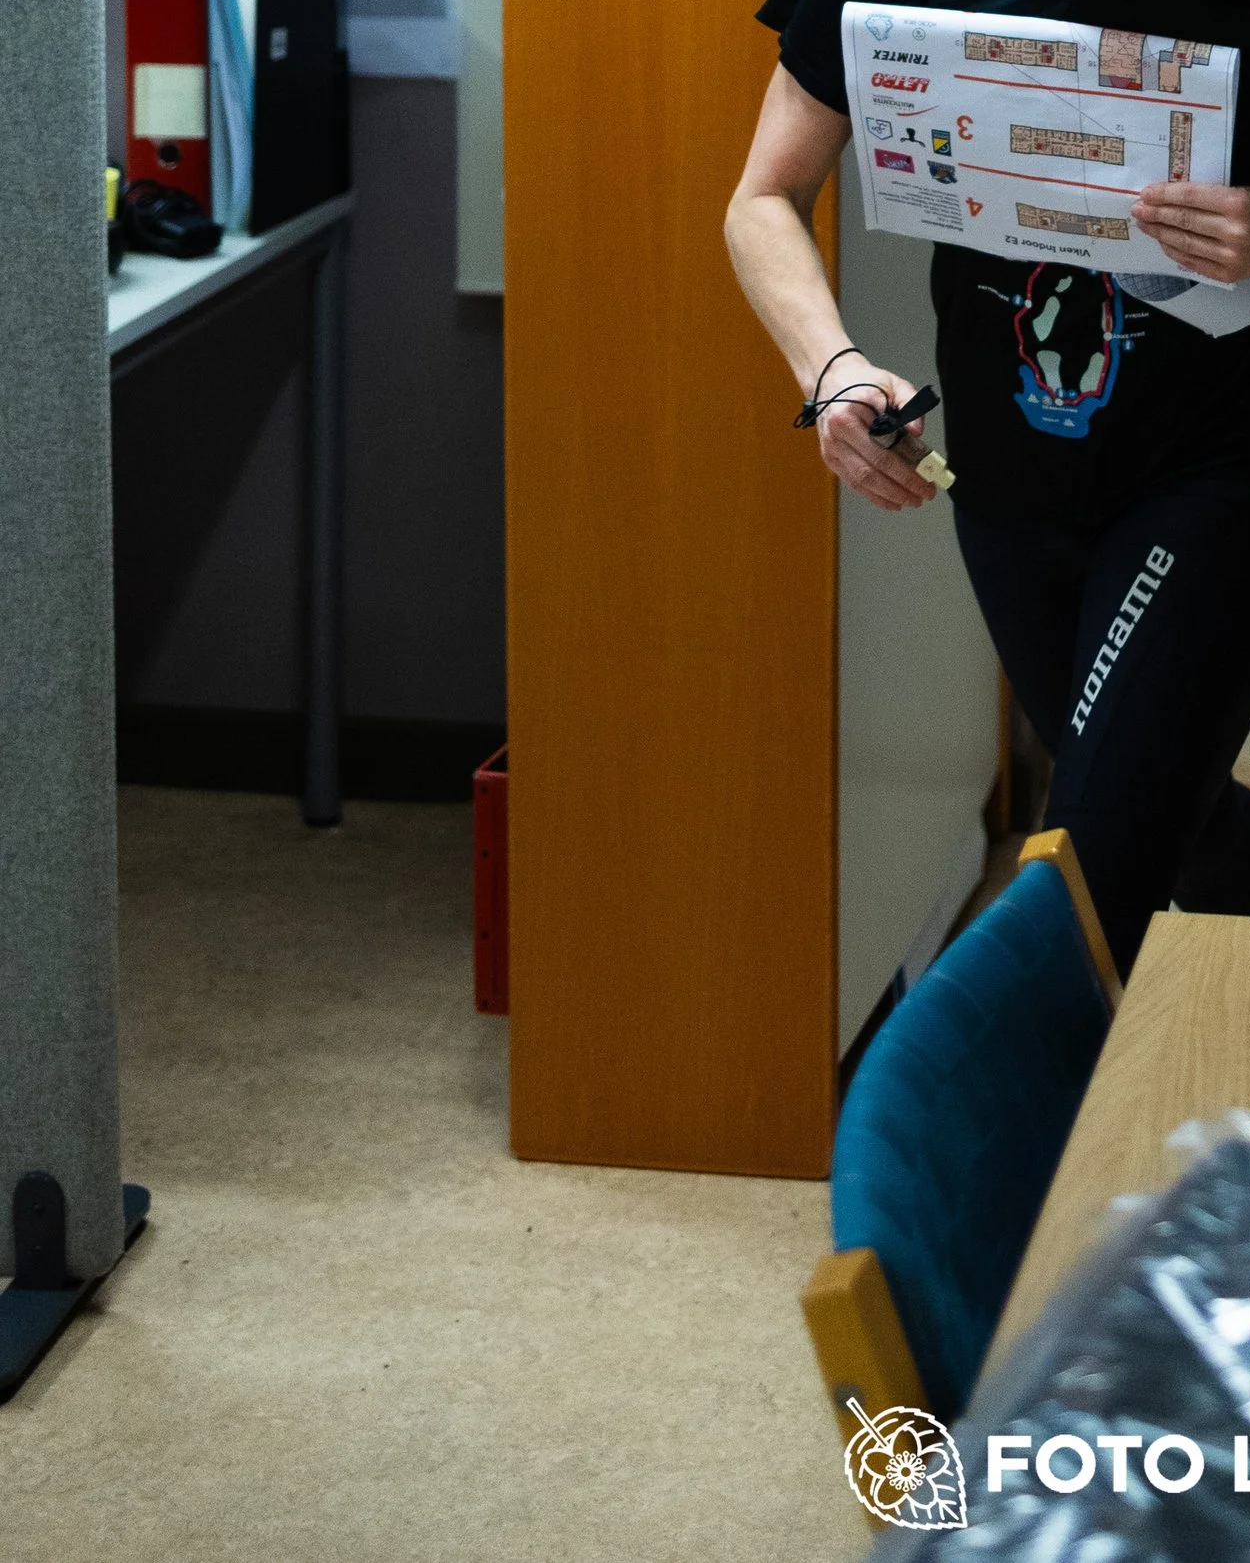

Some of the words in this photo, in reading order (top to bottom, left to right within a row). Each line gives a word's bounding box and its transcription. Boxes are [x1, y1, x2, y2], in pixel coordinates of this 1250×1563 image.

[872, 49, 929, 66] TRIMTEX
[871, 72, 931, 93] LETRO
[956, 115, 974, 140] 3
[966, 197, 984, 217] 4
[1004, 234, 1018, 246] E2
[1021, 237, 1057, 253] Indoor
[1059, 245, 1091, 258] Viken
[1071, 544, 1175, 737] noname
